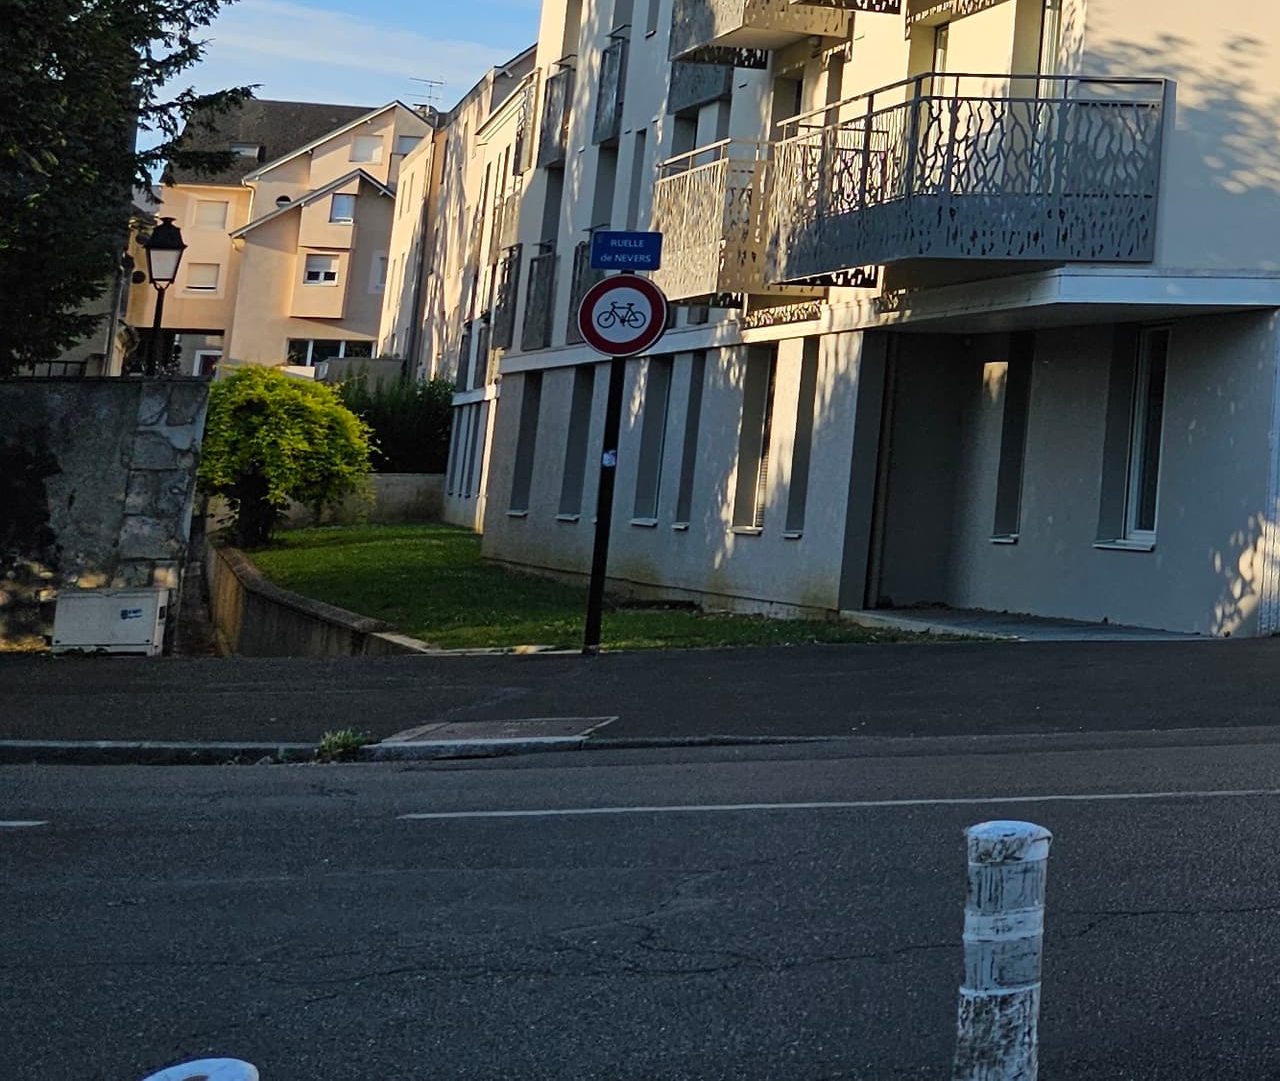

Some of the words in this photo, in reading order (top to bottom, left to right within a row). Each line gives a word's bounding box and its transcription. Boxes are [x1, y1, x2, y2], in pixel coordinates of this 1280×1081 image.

[610, 239, 644, 248] RUELLE
[600, 253, 612, 262] de
[614, 254, 651, 262] NEVERS
